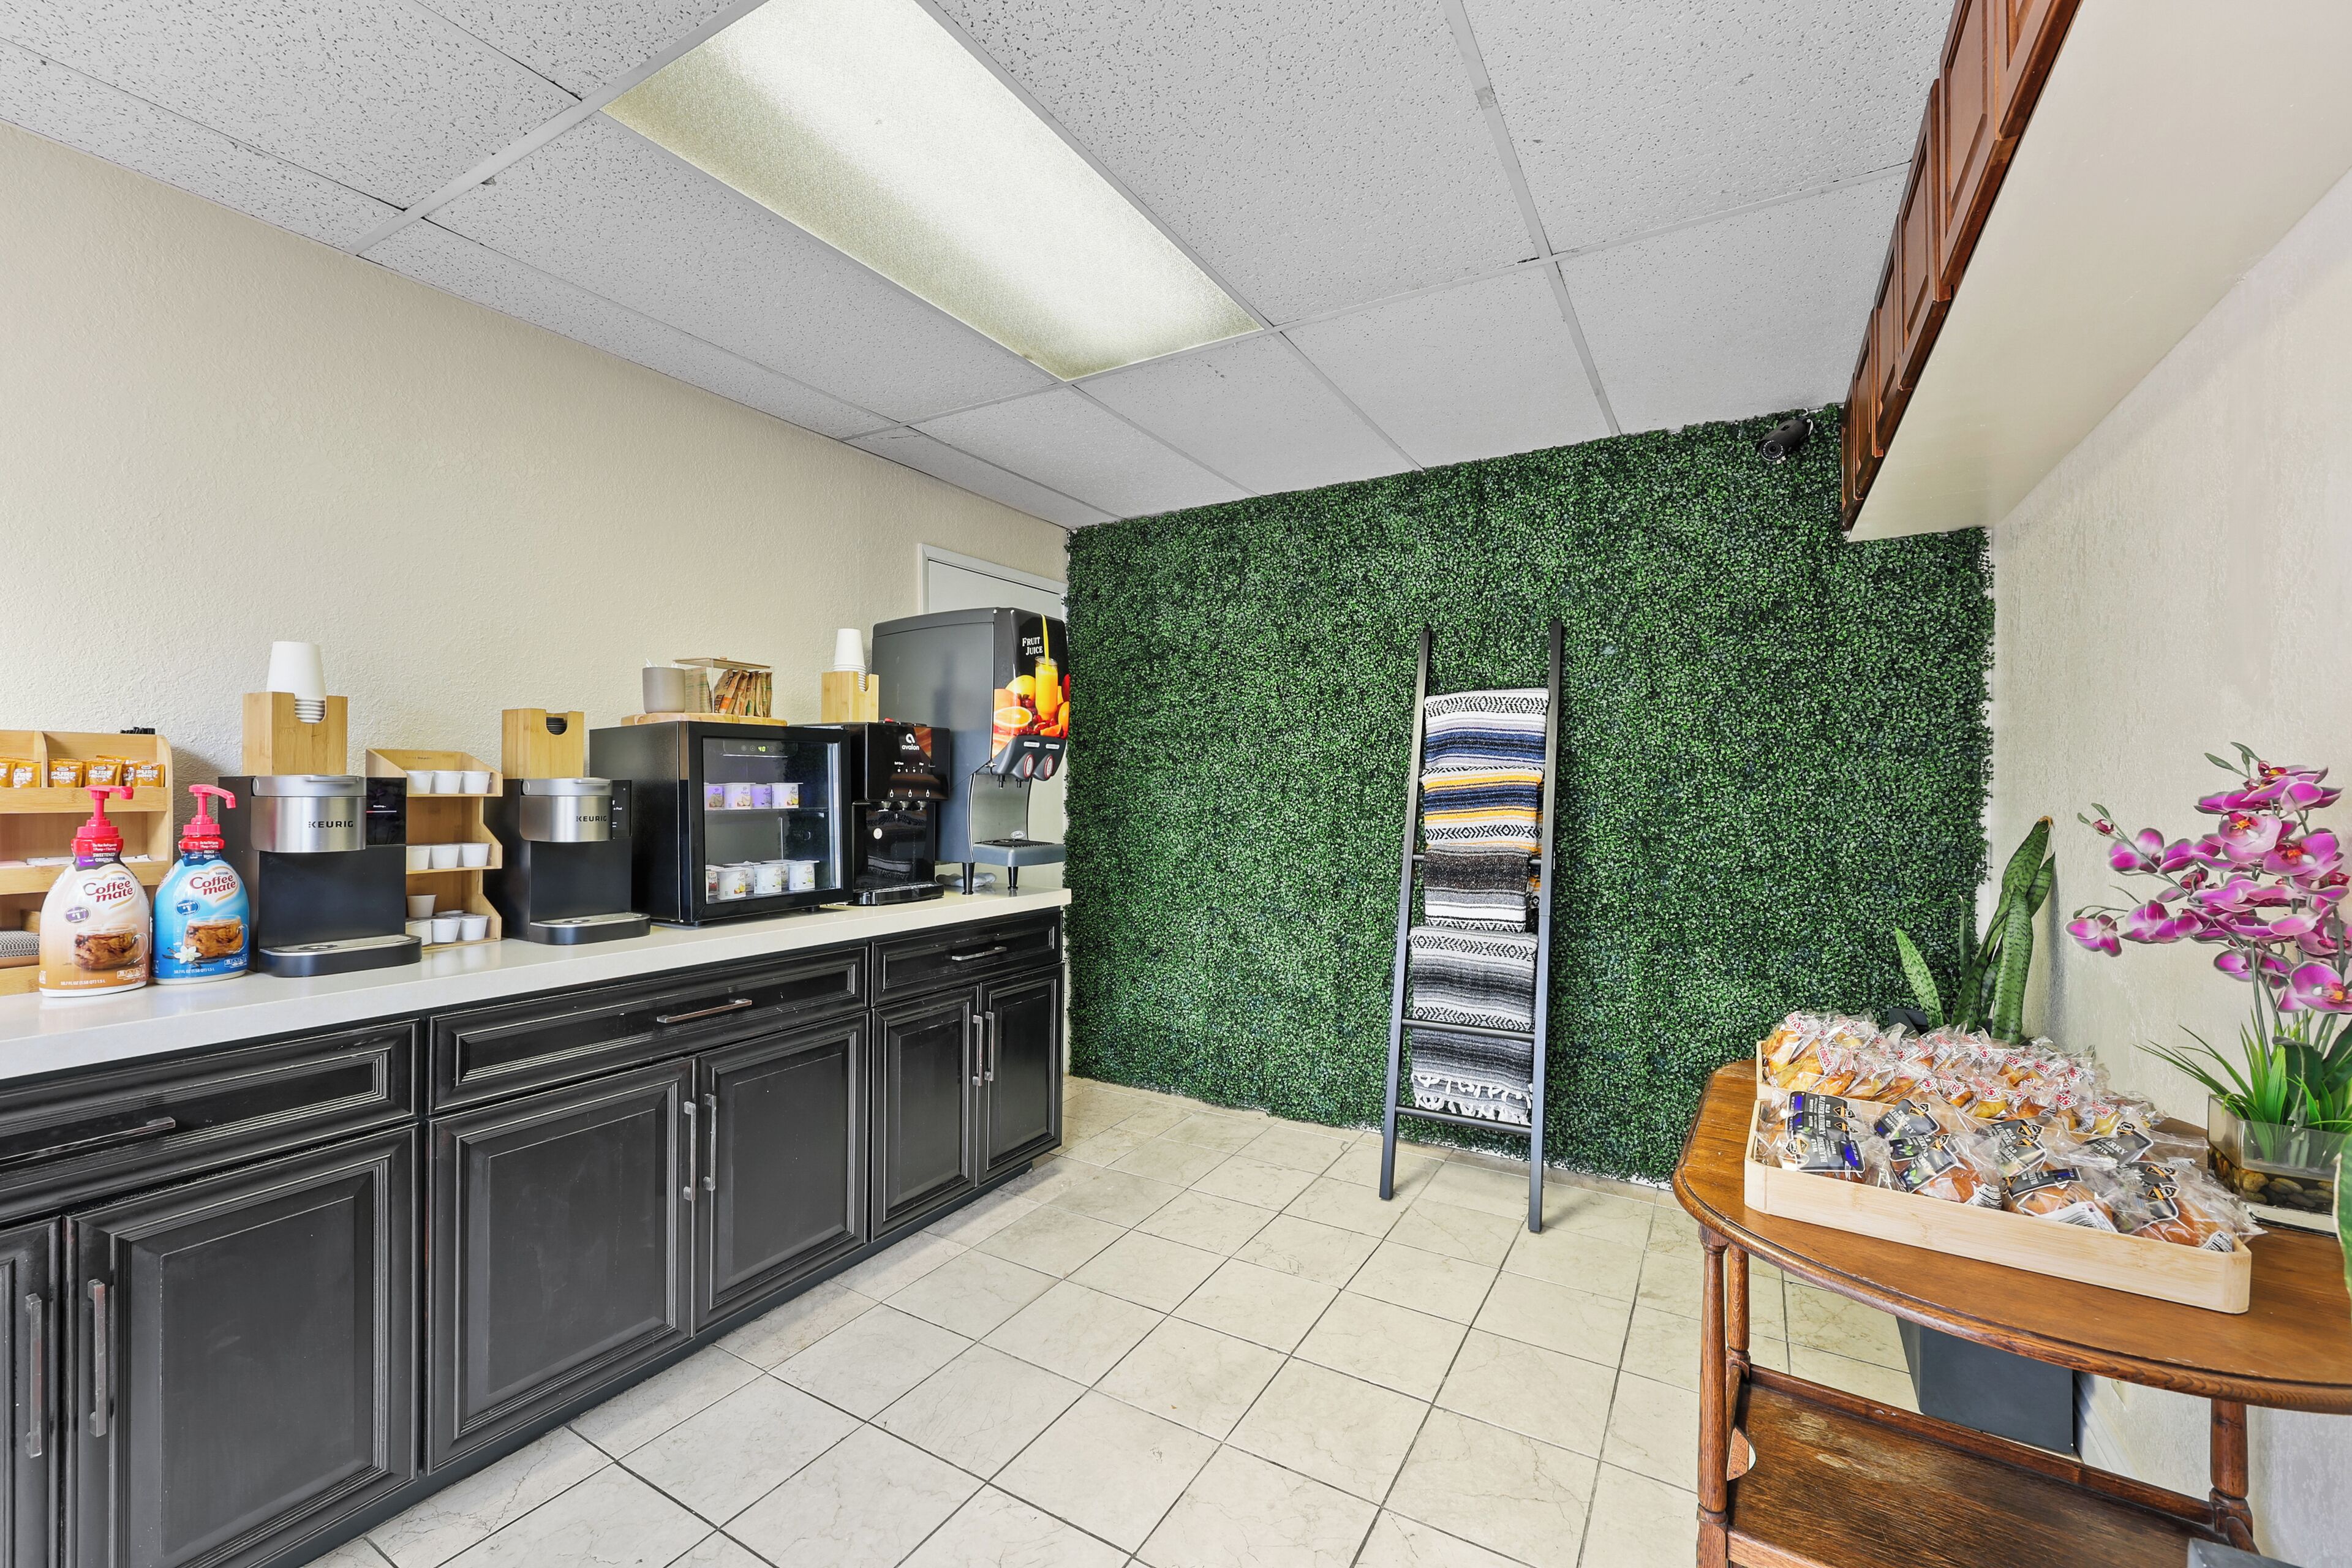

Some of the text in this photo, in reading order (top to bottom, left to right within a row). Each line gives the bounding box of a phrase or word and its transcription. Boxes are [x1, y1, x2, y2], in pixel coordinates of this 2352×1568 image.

[1022, 636, 1040, 647] FRUIT
[1025, 646, 1043, 655] JUICE
[83, 880, 130, 896] Coffee
[189, 875, 233, 889] Coffee
[203, 881, 236, 895] mate
[96, 887, 133, 903] mate
[1884, 1117, 1900, 1130] MUFFI
[2005, 1128, 2017, 1140] WILD
[1817, 1136, 1828, 1163] BLUEBER
